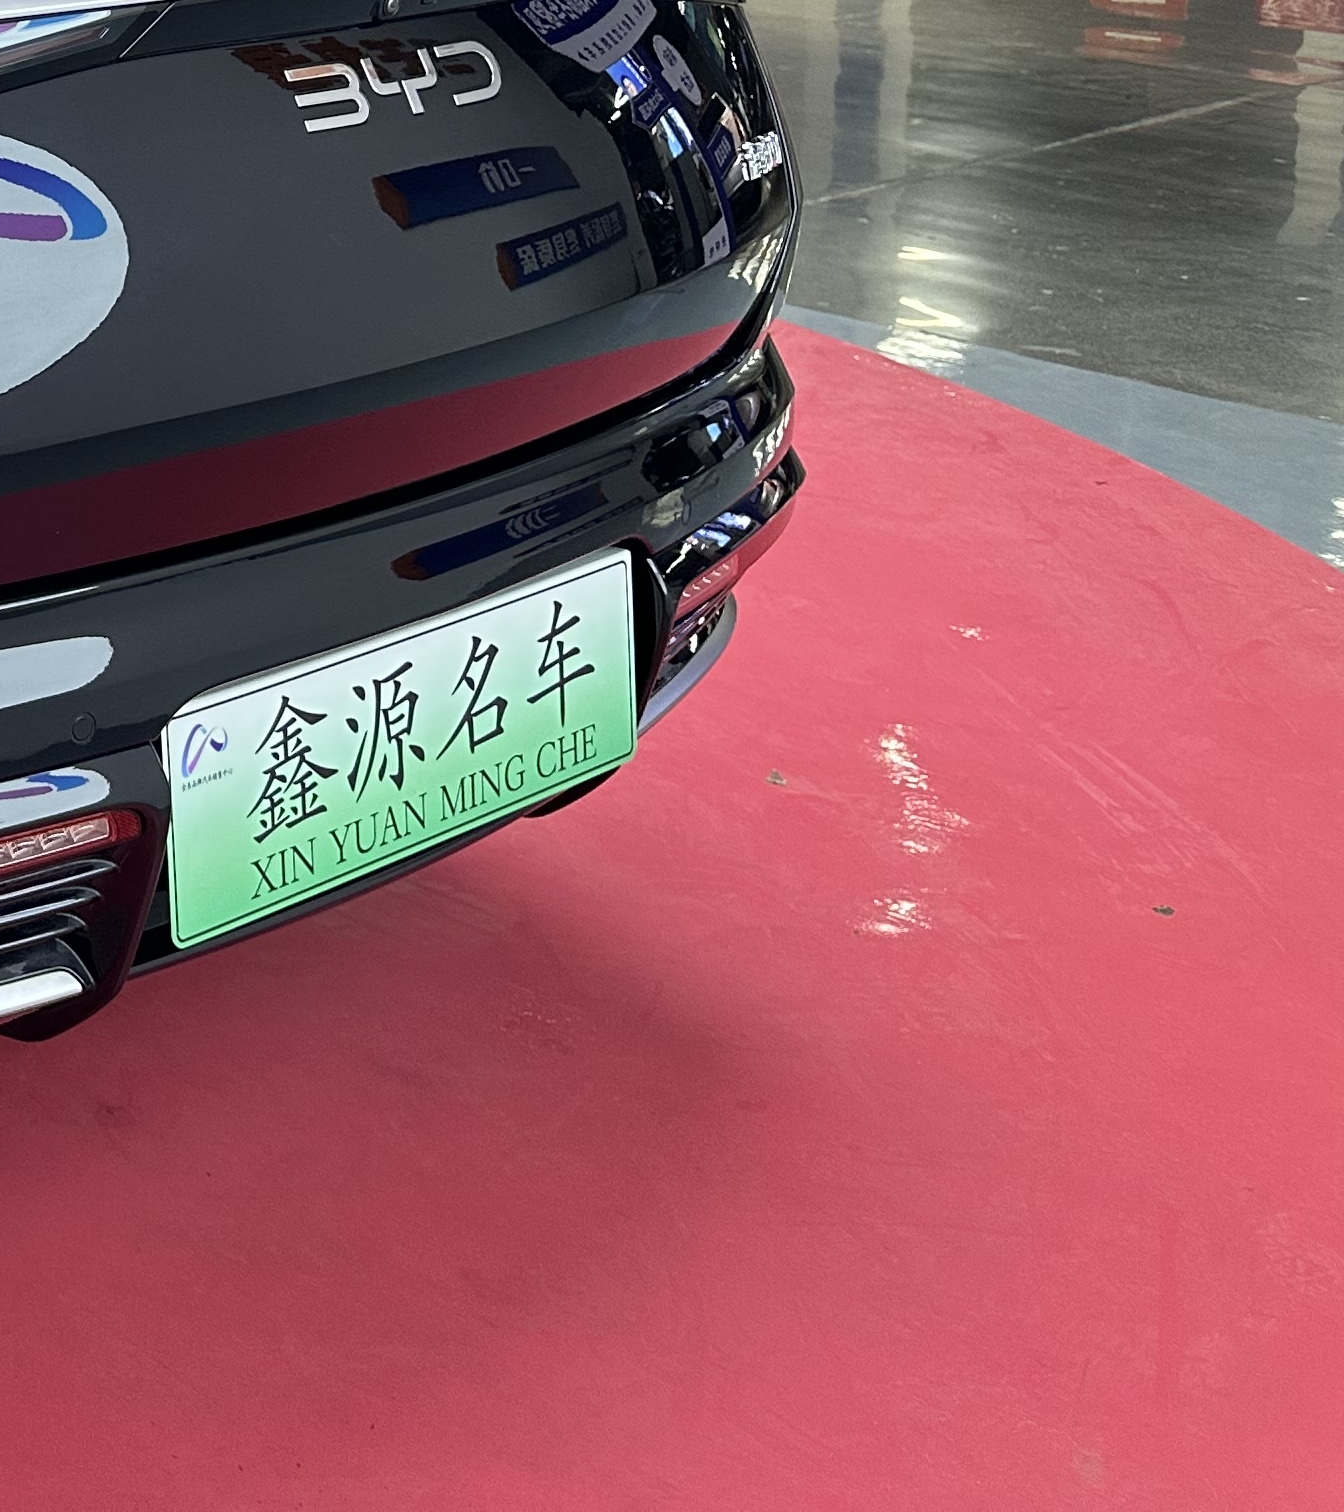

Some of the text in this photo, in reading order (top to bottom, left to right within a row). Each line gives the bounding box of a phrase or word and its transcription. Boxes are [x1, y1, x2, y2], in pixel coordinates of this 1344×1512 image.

[246, 599, 596, 845] 鑫源名车
[250, 723, 599, 900] XIN YUAN MING CHE
